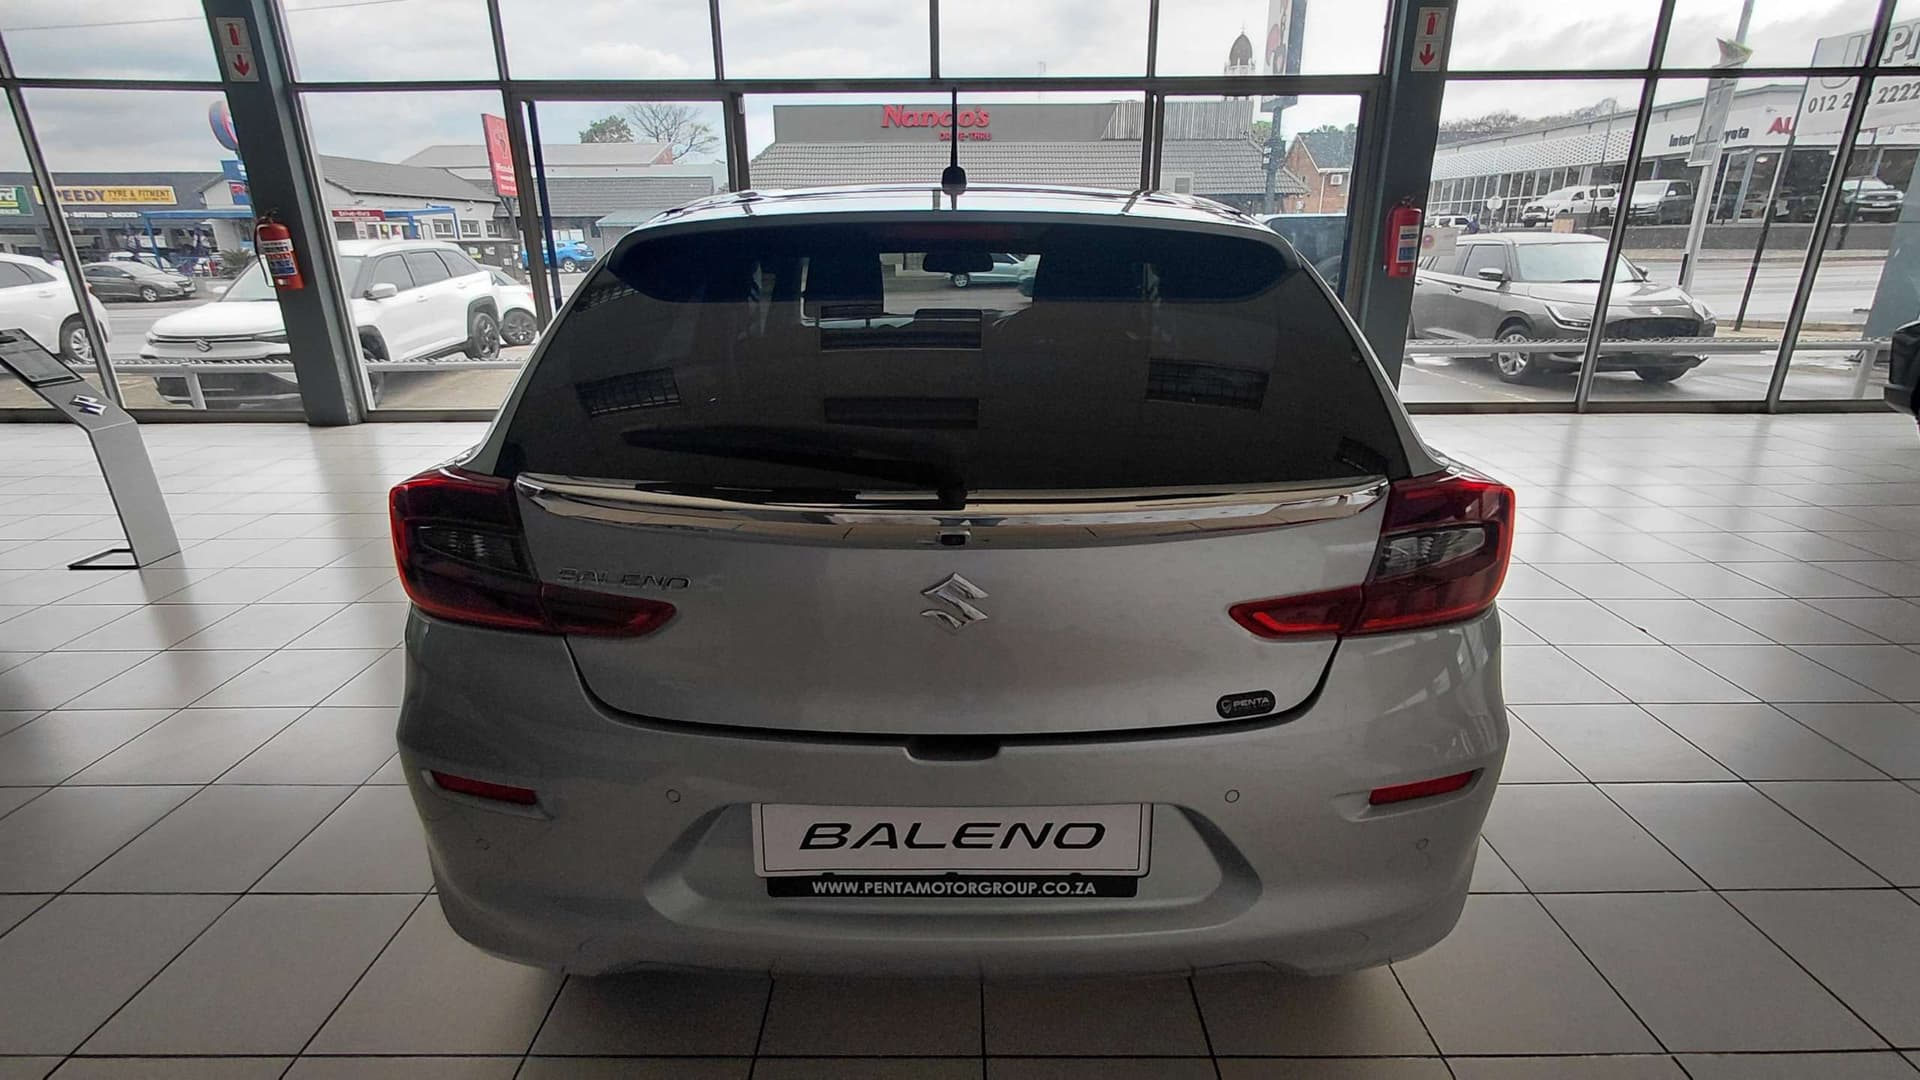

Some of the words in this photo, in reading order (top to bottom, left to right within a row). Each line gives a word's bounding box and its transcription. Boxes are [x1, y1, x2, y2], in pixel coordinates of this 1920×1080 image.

[1808, 95, 1838, 114] 012
[1876, 81, 1920, 105] 2222
[939, 131, 992, 141] DRE-THRU
[558, 567, 692, 591] BALENO
[1232, 696, 1270, 708] PENTA
[799, 822, 1107, 850] BALENO
[812, 880, 1097, 896] WWW.PENTAMOTORGROUP.CO.ZA
